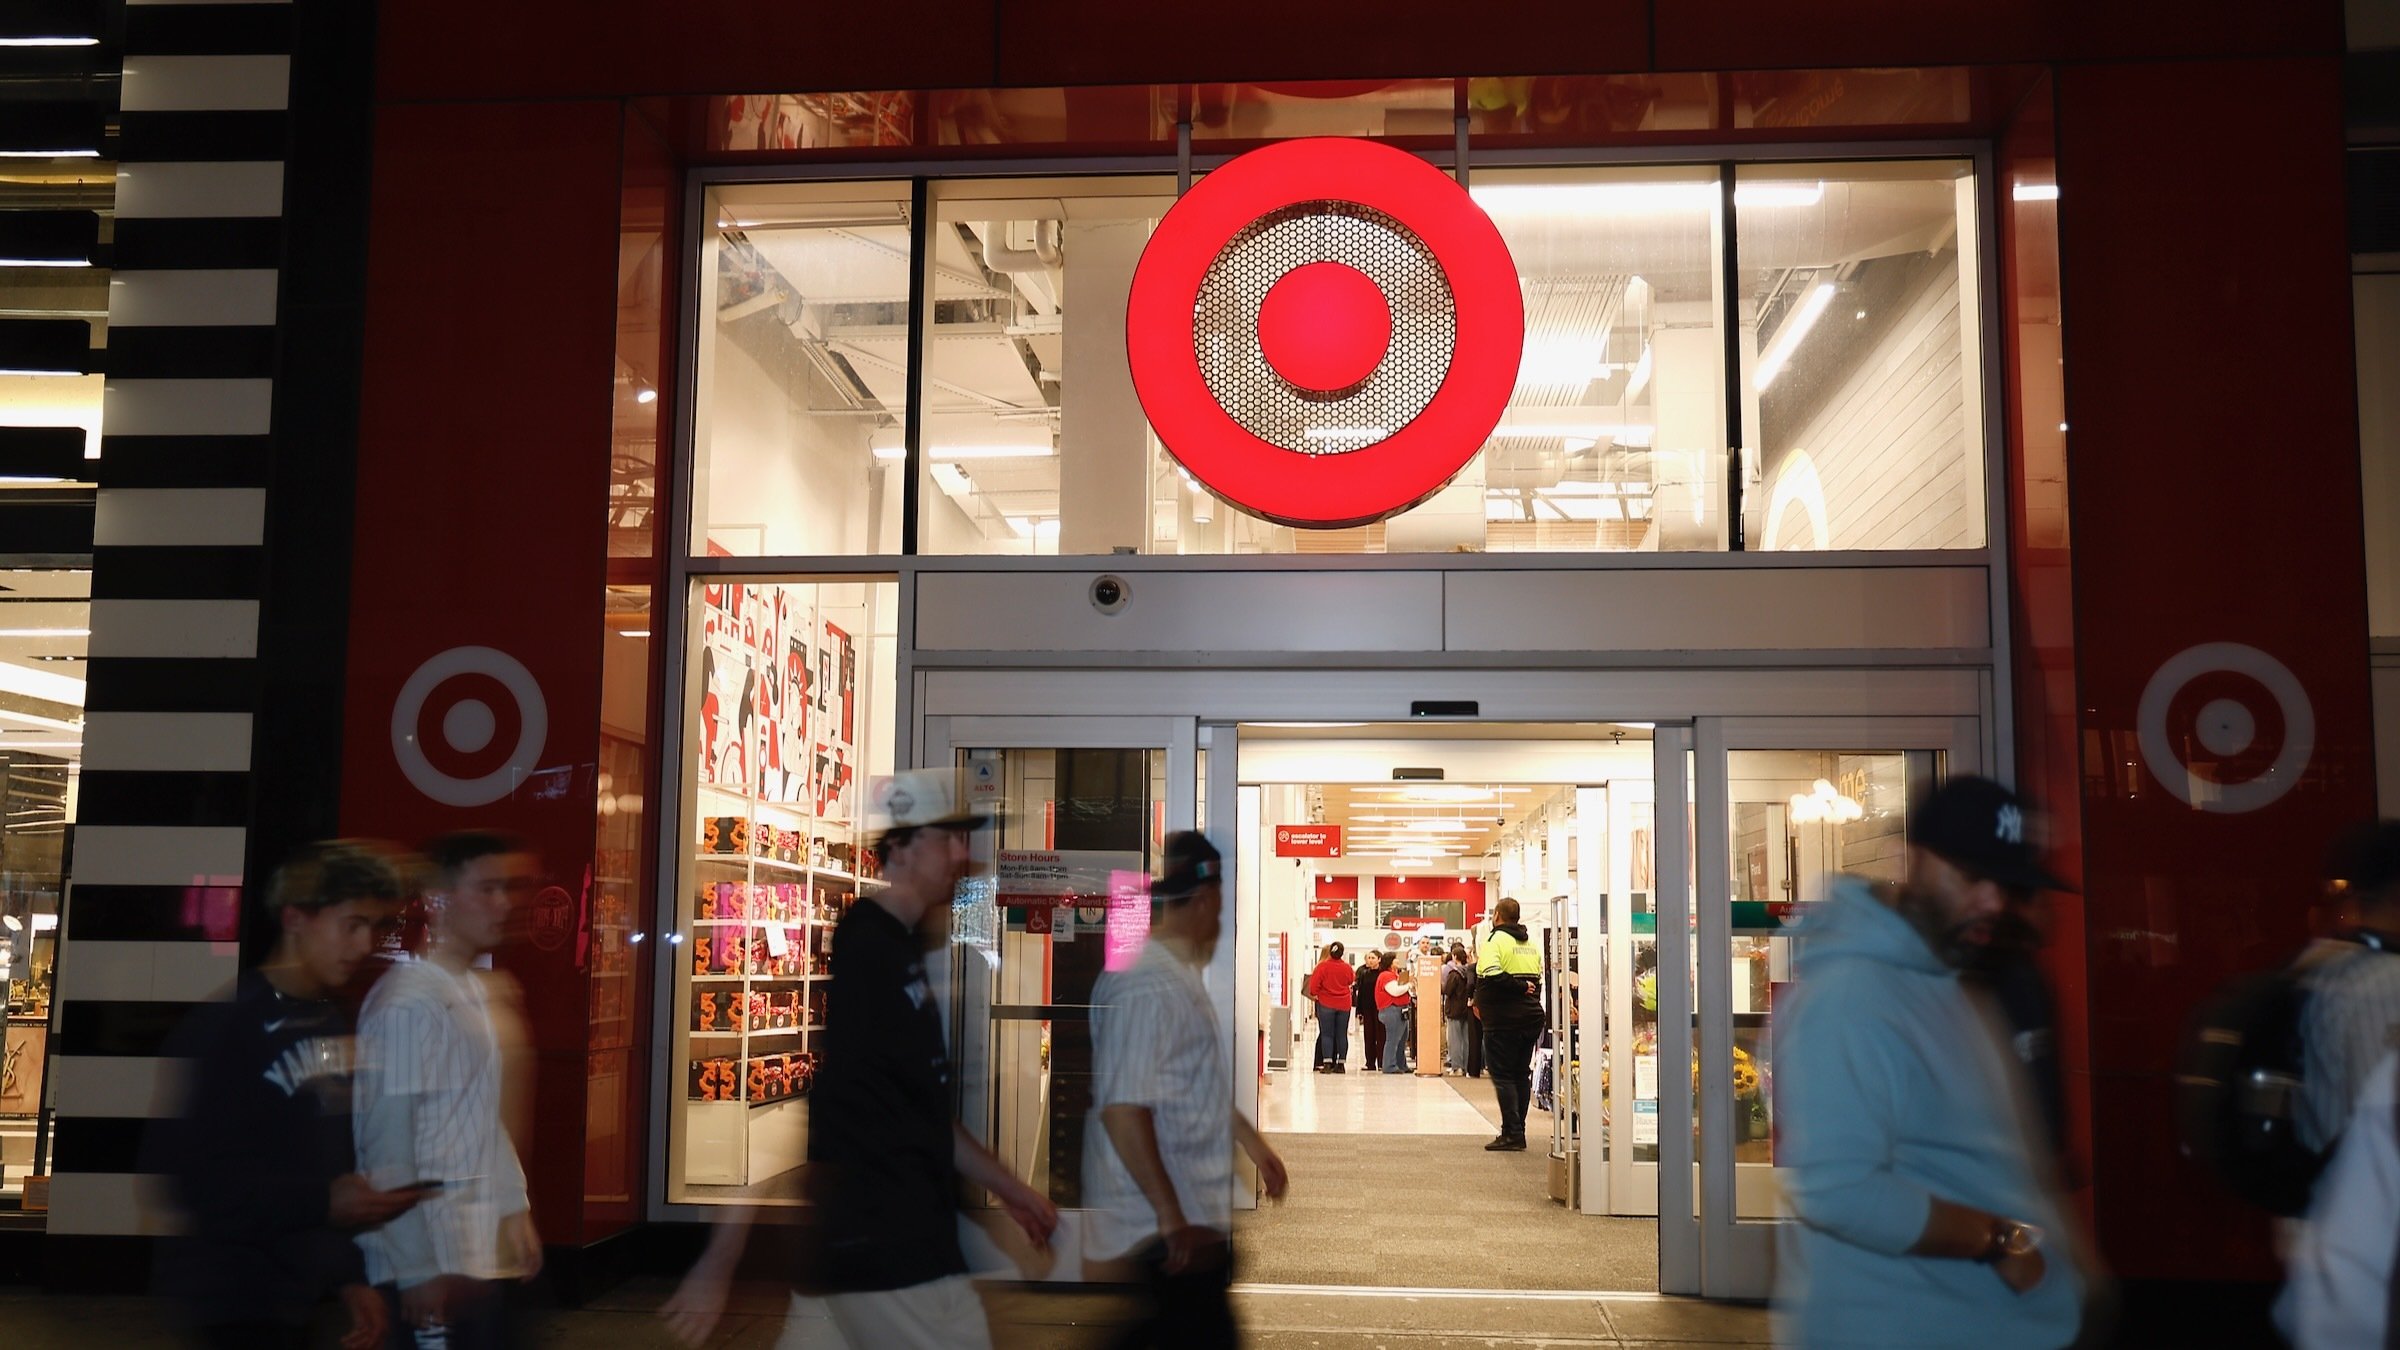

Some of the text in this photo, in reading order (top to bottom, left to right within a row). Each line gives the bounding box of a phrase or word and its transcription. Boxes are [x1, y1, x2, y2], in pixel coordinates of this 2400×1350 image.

[975, 784, 995, 792] ALTO
[1000, 852, 1060, 863] Store Hours
[1005, 897, 1047, 905] Automatic
